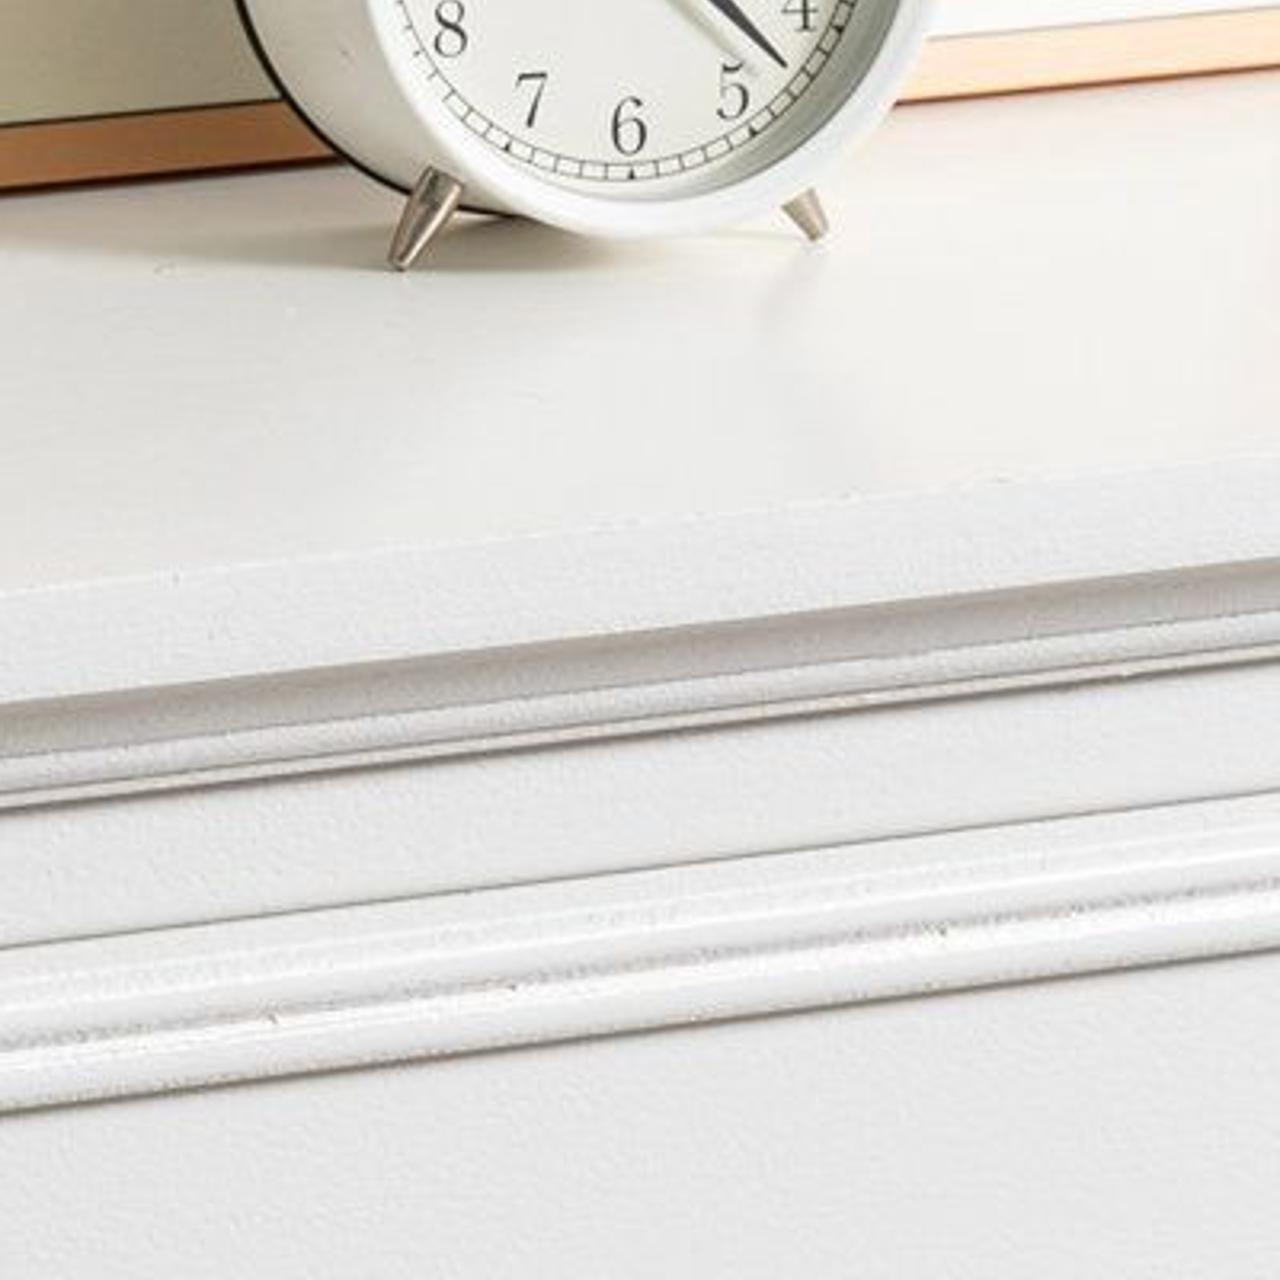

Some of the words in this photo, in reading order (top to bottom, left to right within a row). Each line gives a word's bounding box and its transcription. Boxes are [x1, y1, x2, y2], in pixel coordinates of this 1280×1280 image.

[515, 70, 549, 129] 7
[715, 63, 755, 121] 5
[610, 95, 648, 157] 6
